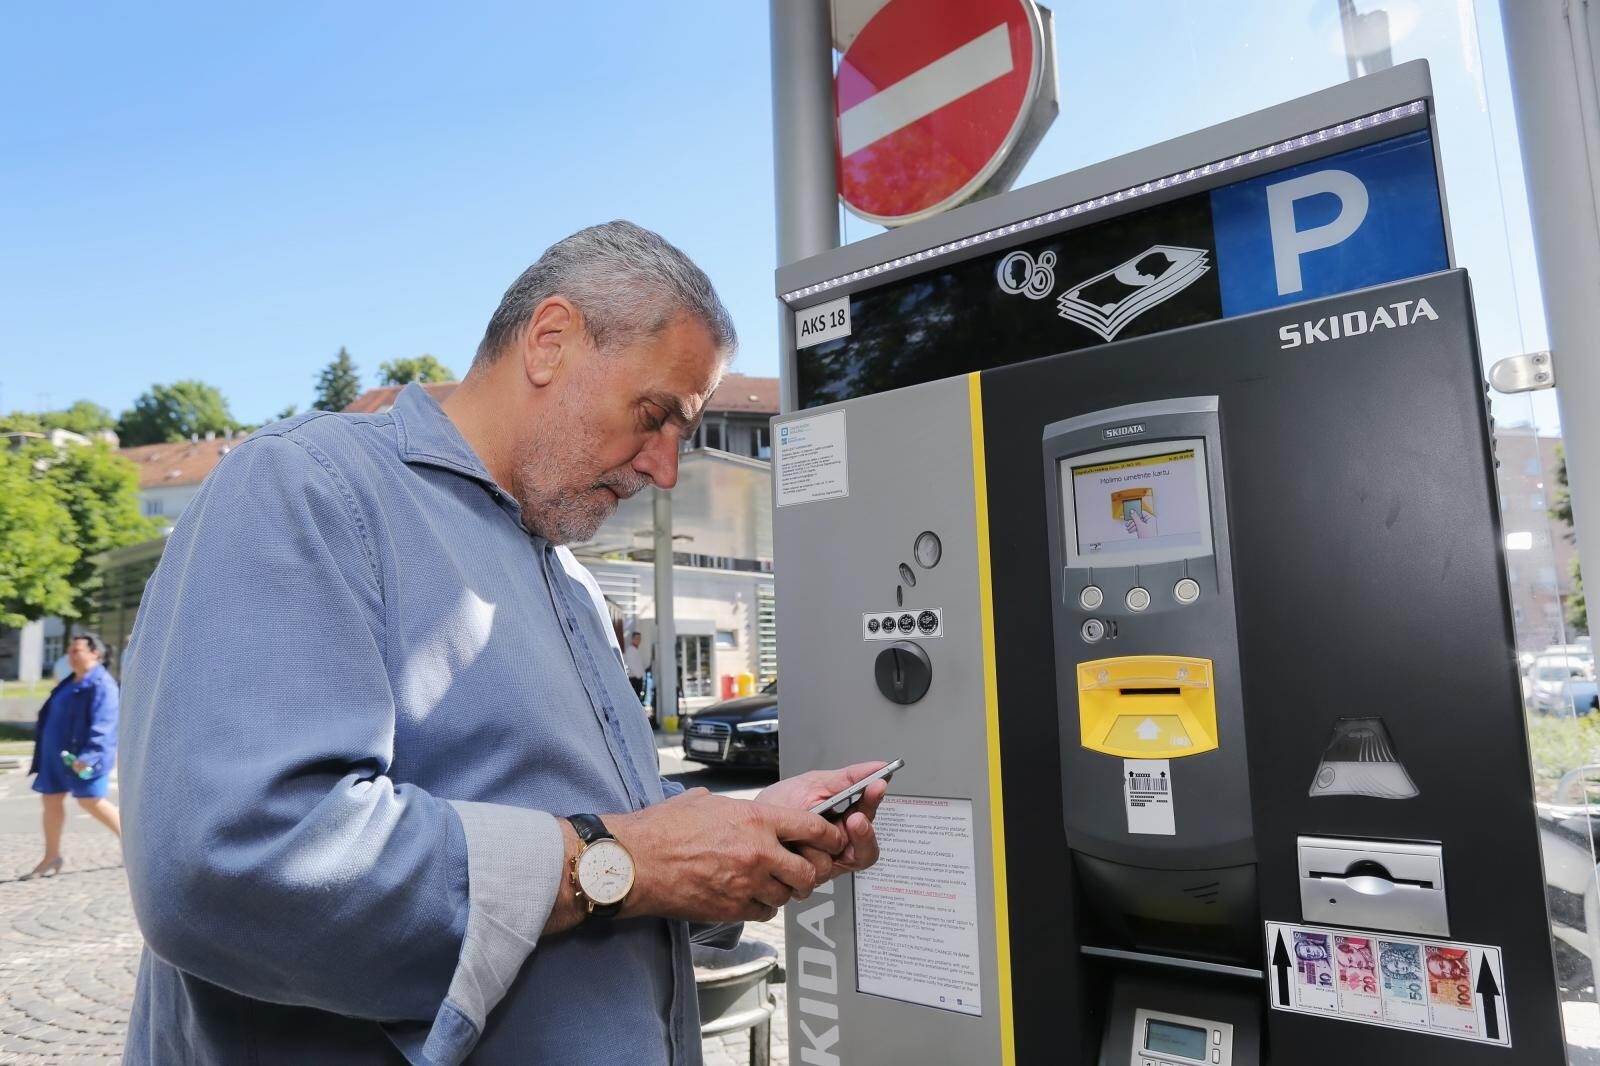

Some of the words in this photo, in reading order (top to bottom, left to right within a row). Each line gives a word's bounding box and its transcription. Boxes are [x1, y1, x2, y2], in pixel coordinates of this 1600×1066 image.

[1266, 169, 1370, 296] P
[801, 314, 826, 337] AKS
[830, 308, 846, 329] 18
[1278, 297, 1440, 350] SKIDATA
[1106, 424, 1144, 438] SKIDATA
[1152, 468, 1170, 479] kartu
[1319, 972, 1333, 986] 10
[1362, 975, 1377, 994] 20
[1408, 982, 1423, 1001] 50
[1456, 984, 1471, 1005] 100
